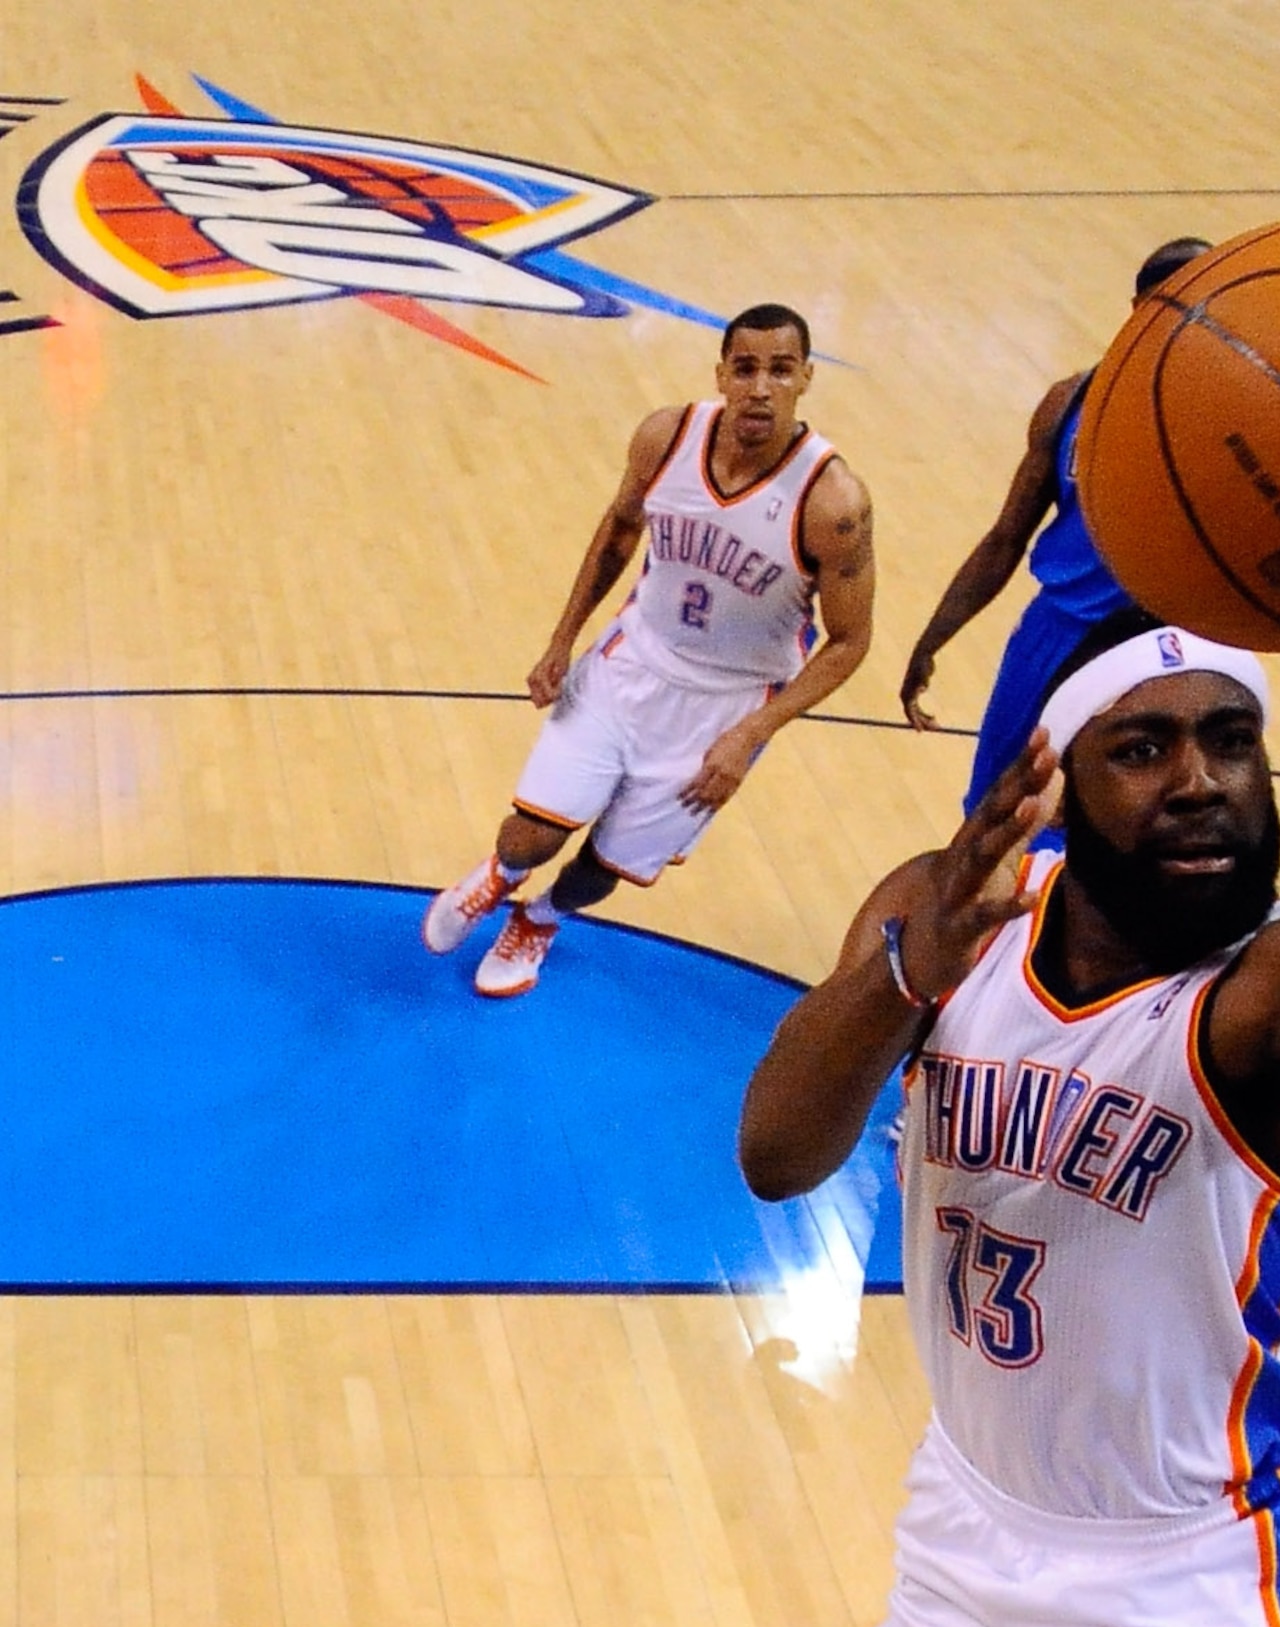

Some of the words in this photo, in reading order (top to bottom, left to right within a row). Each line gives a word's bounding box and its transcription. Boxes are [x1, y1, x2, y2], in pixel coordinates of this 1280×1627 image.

[646, 513, 786, 598] THUNDER
[680, 580, 714, 631] 2
[935, 1206, 1047, 1370] 13
